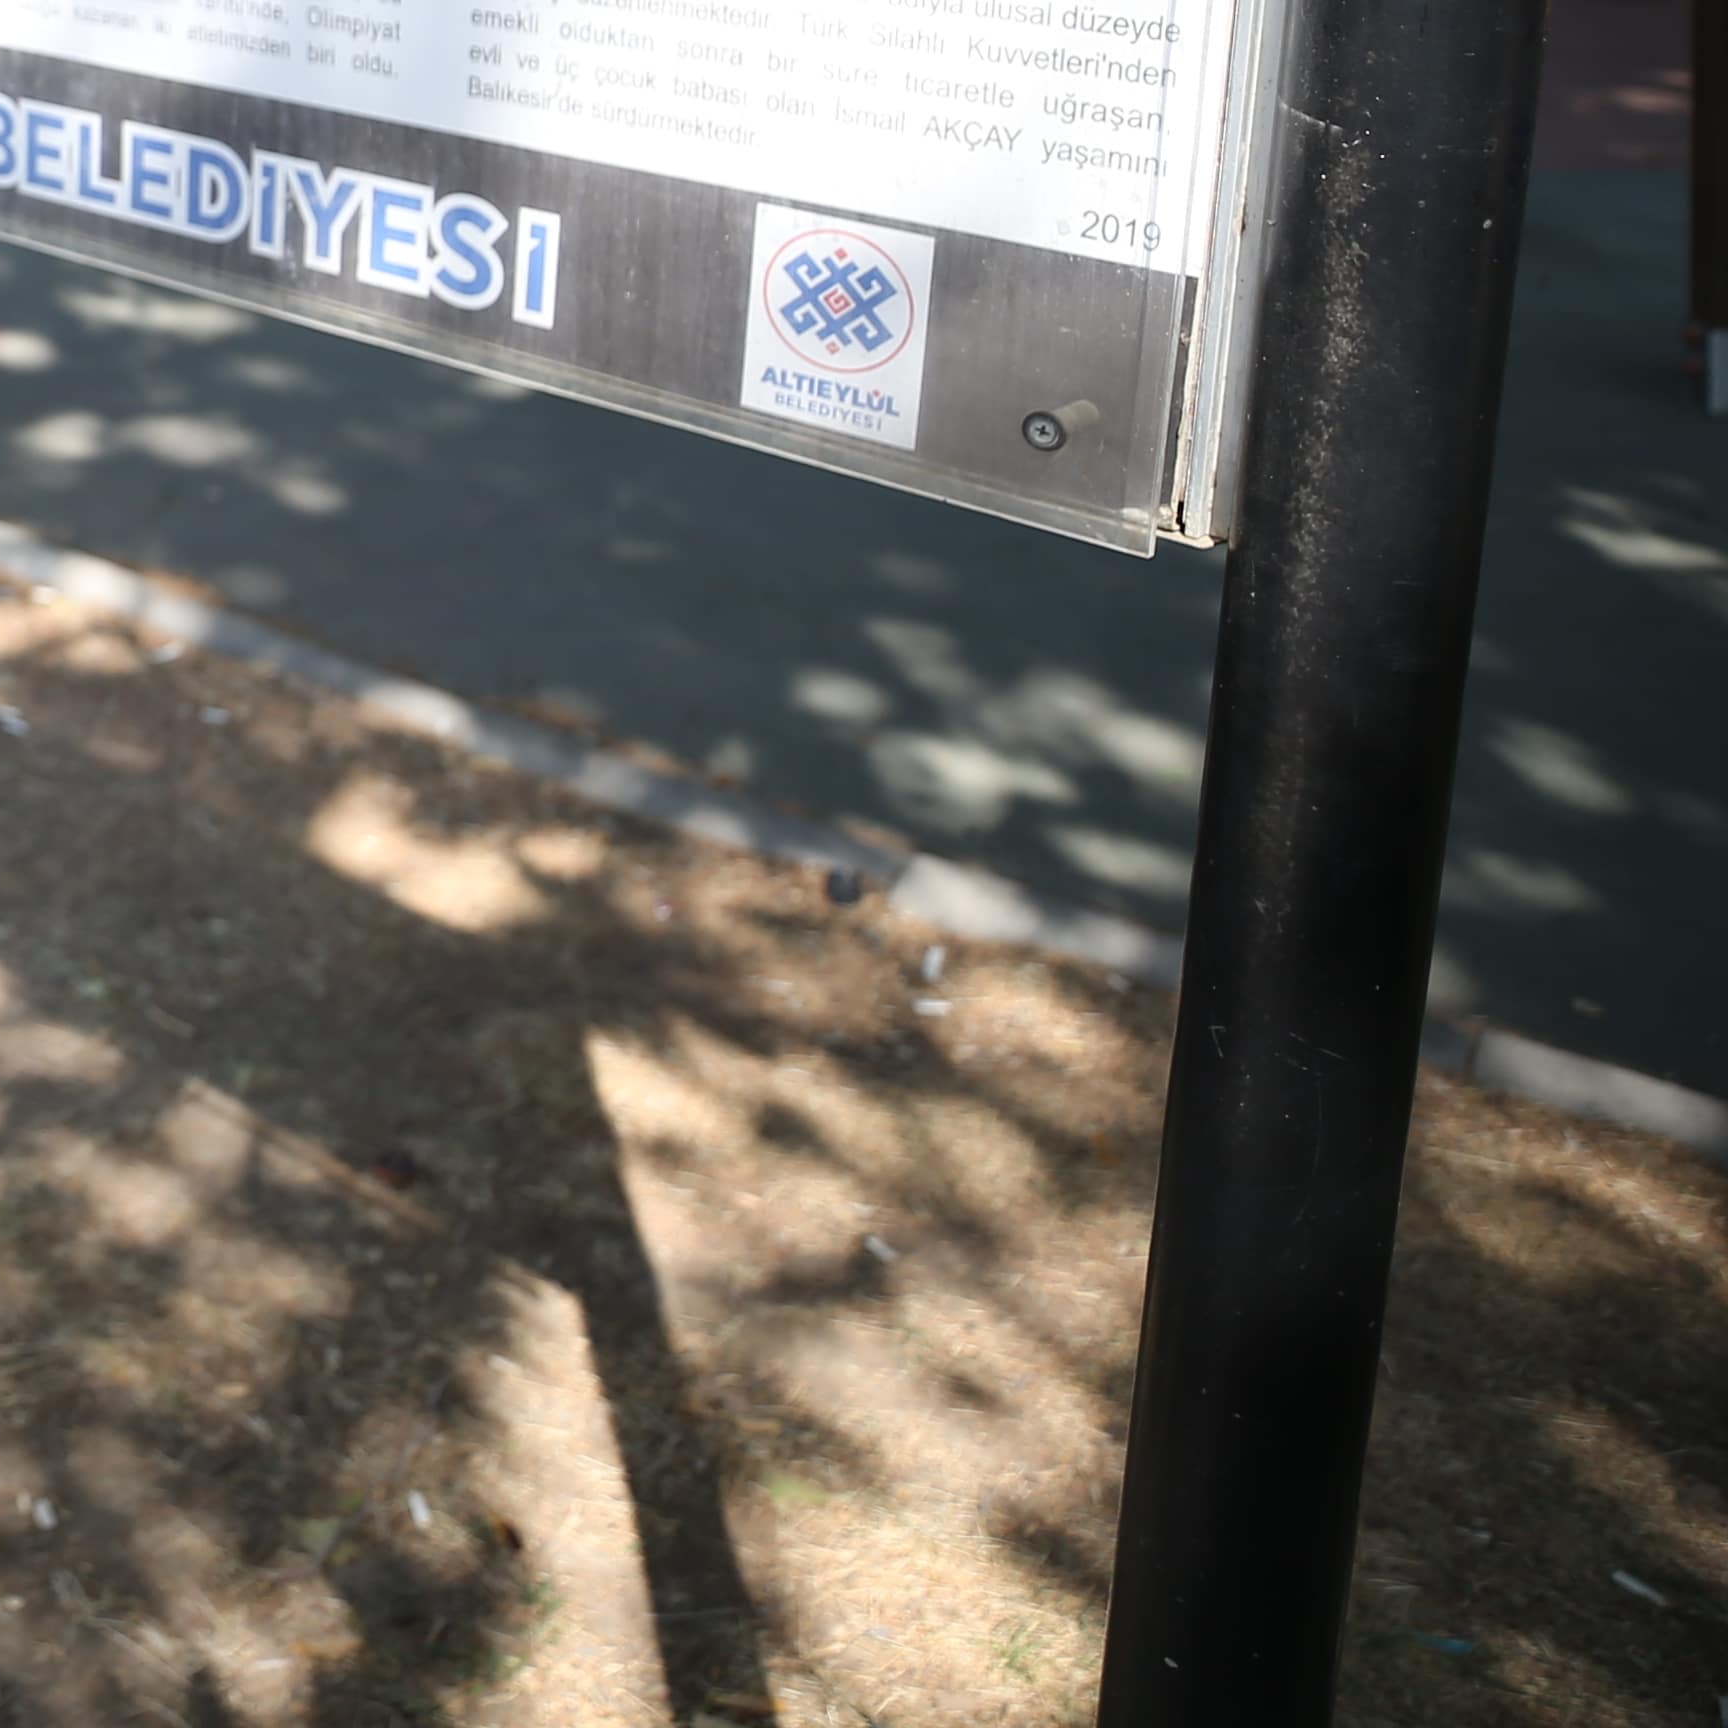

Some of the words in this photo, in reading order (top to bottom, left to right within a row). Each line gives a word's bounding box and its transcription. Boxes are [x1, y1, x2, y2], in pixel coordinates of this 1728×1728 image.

[1061, 6, 1180, 45] düzeyde
[470, 7, 539, 35] emekli
[559, 19, 655, 53] olduktan
[676, 38, 743, 67] sonra
[1043, 91, 1170, 137] uğraşan,
[968, 36, 1176, 88] Kuvvetleri'nden
[469, 43, 502, 69] evli
[516, 52, 540, 71] ve
[594, 64, 656, 92] çocuk
[674, 75, 747, 107] babası
[765, 90, 815, 119] olan
[922, 114, 1022, 152] AKÇAY
[1042, 135, 1167, 178] yaşamını
[1080, 209, 1162, 252] 2019
